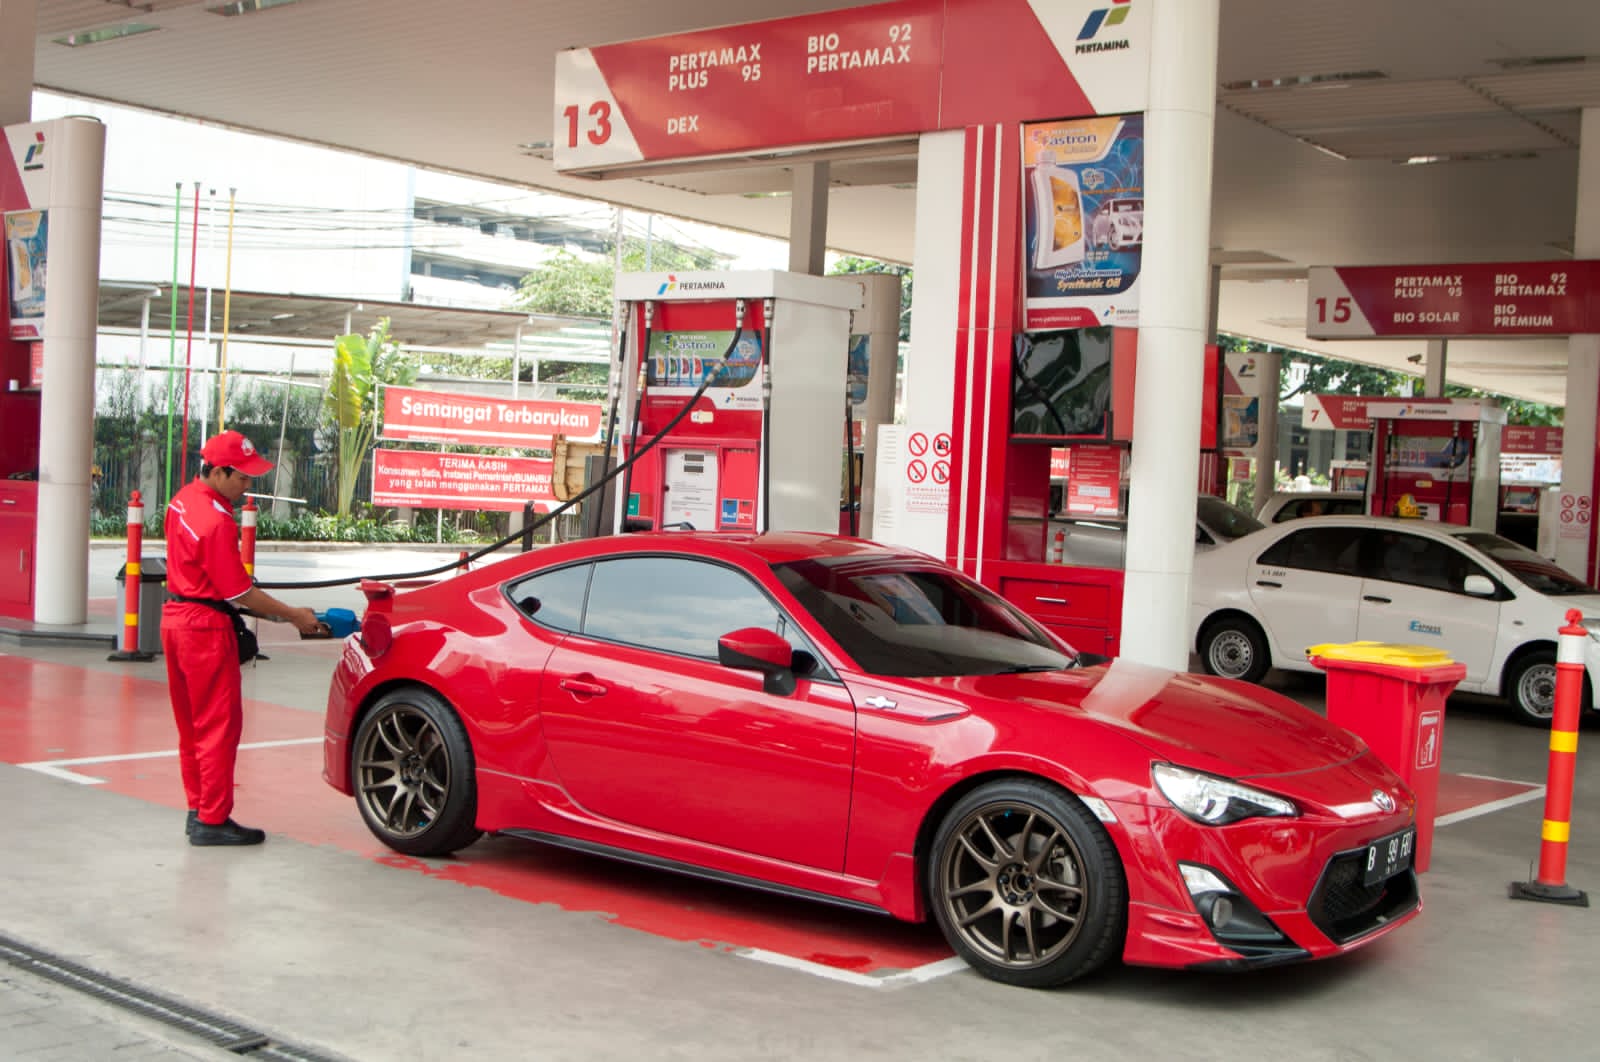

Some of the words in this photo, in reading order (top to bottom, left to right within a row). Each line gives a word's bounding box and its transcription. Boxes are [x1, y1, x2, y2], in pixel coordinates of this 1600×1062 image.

[807, 33, 840, 53] BIO
[889, 23, 912, 43] 92
[1075, 40, 1130, 54] PERTAMINA
[669, 43, 761, 73] PERTAMAX
[807, 45, 911, 74] PERTAMAX
[669, 70, 708, 92] PLUS
[742, 63, 761, 82] 95
[563, 100, 612, 149] 13
[667, 115, 699, 135] DEX
[679, 281, 726, 290] PERTAMINA
[1394, 275, 1463, 287] PERTAMAX
[1495, 274, 1518, 285] BIO
[1550, 272, 1567, 284] 92
[1394, 287, 1424, 299] PLUS
[1447, 287, 1463, 297] 95
[1494, 285, 1566, 297] PERTAMAX
[1315, 297, 1352, 324] 15
[1393, 312, 1415, 323] BIO
[1418, 311, 1460, 323] SOLAR
[1493, 304, 1517, 315] BIO
[1493, 315, 1553, 328] PREMIUM
[401, 396, 491, 424] Semangat
[497, 404, 589, 427] Terbarukan
[1311, 410, 1319, 422] 7
[438, 457, 476, 469] TERIMA
[478, 460, 507, 472] KASIH
[389, 479, 412, 489] yang
[503, 482, 549, 494] PERTAMAX
[1367, 845, 1377, 871] B
[1387, 837, 1399, 864] 99
